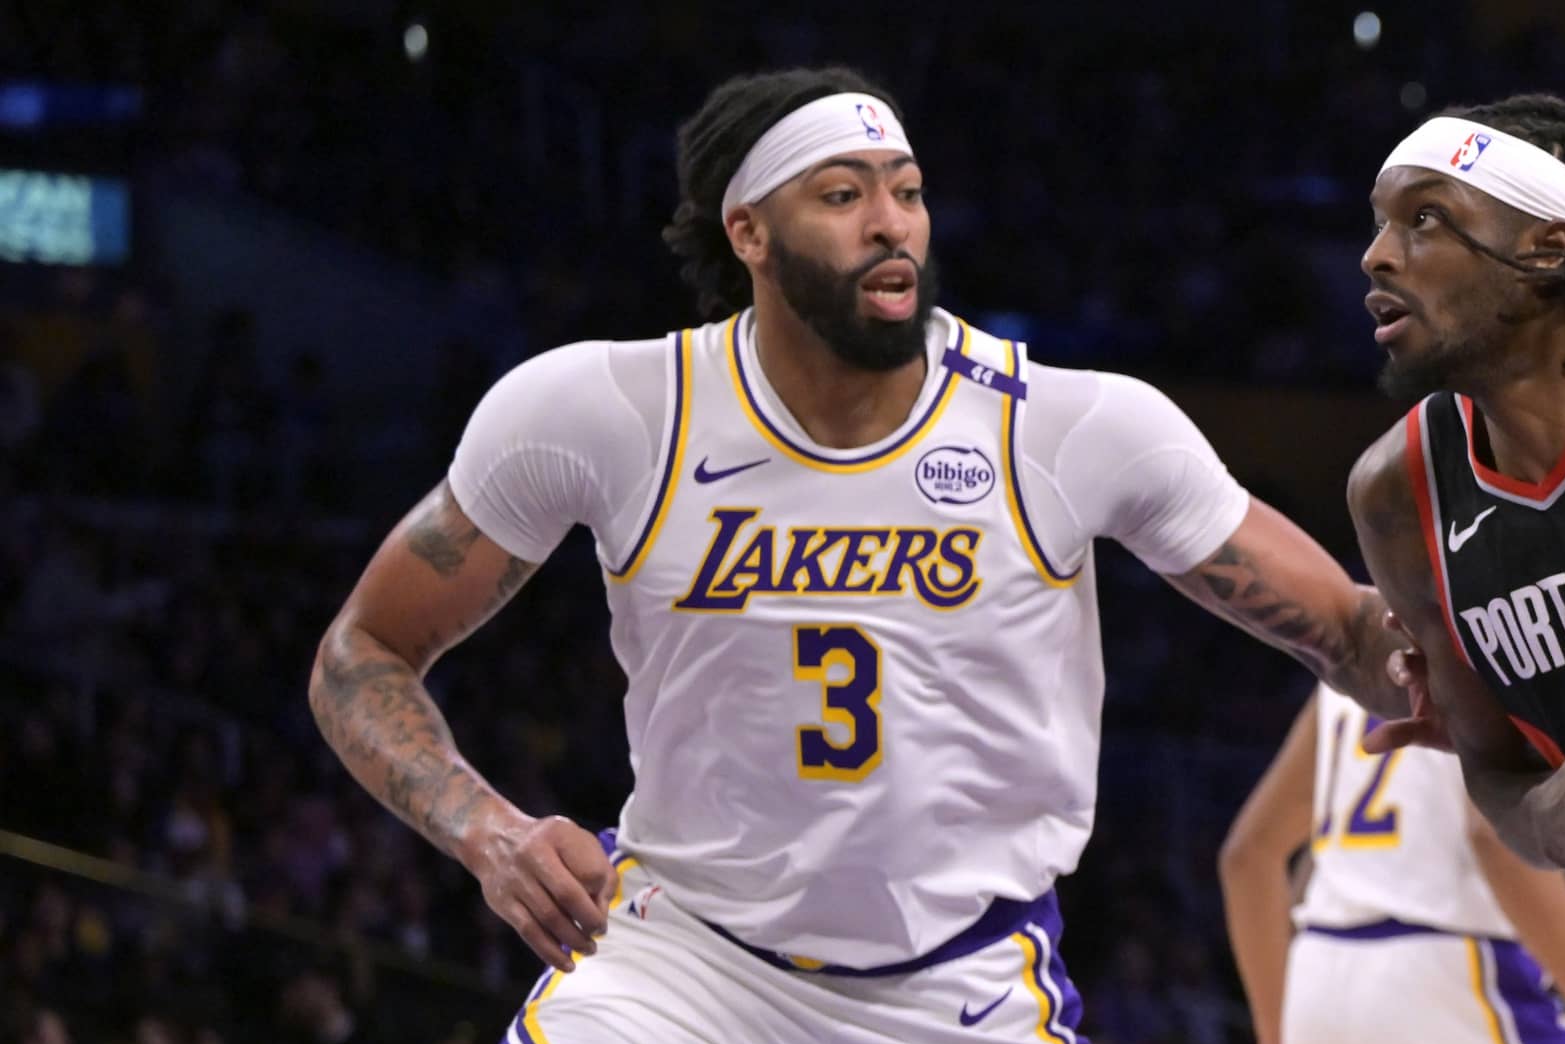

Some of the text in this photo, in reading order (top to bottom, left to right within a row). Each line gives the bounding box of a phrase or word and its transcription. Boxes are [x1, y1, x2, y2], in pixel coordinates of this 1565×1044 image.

[971, 364, 995, 386] 44
[923, 461, 990, 488] bibigo
[671, 507, 983, 611] LAKERS
[793, 623, 885, 782] 3
